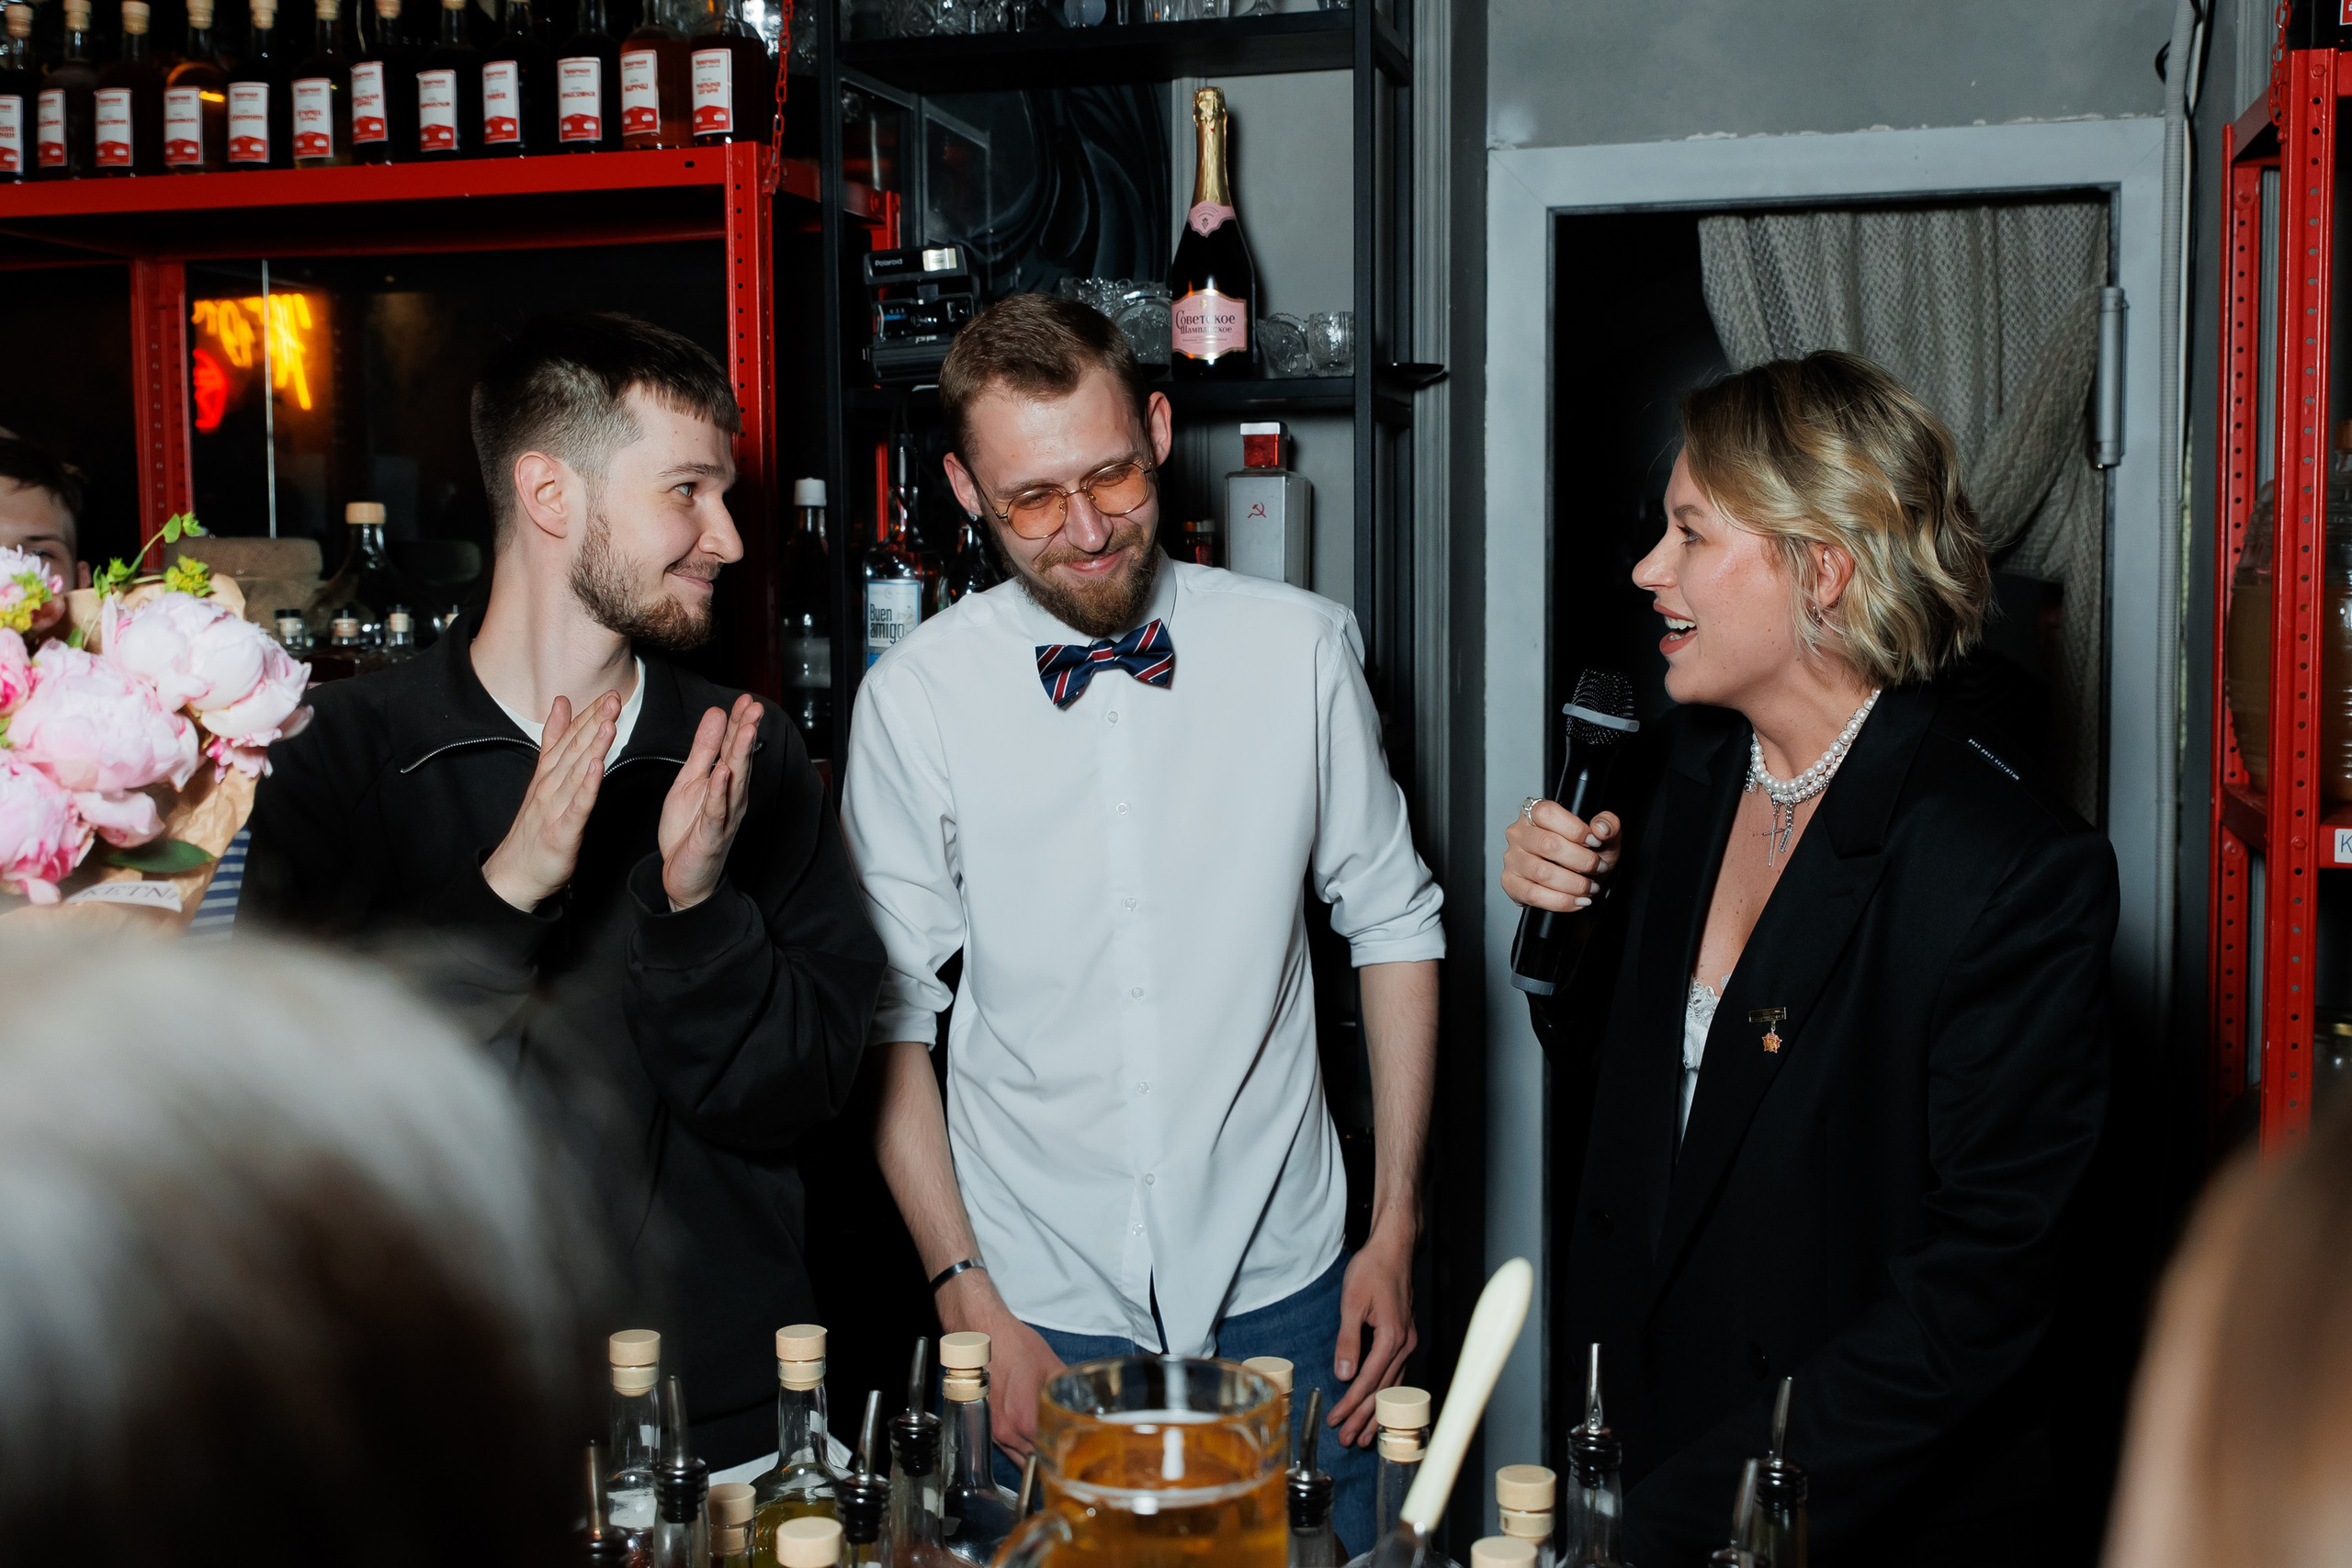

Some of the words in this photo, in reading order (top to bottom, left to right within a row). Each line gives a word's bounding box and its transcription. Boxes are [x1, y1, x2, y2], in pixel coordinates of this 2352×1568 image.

[875, 258, 903, 266] Polaroid
[870, 604, 892, 622] Buen
[870, 623, 904, 644] amigo
